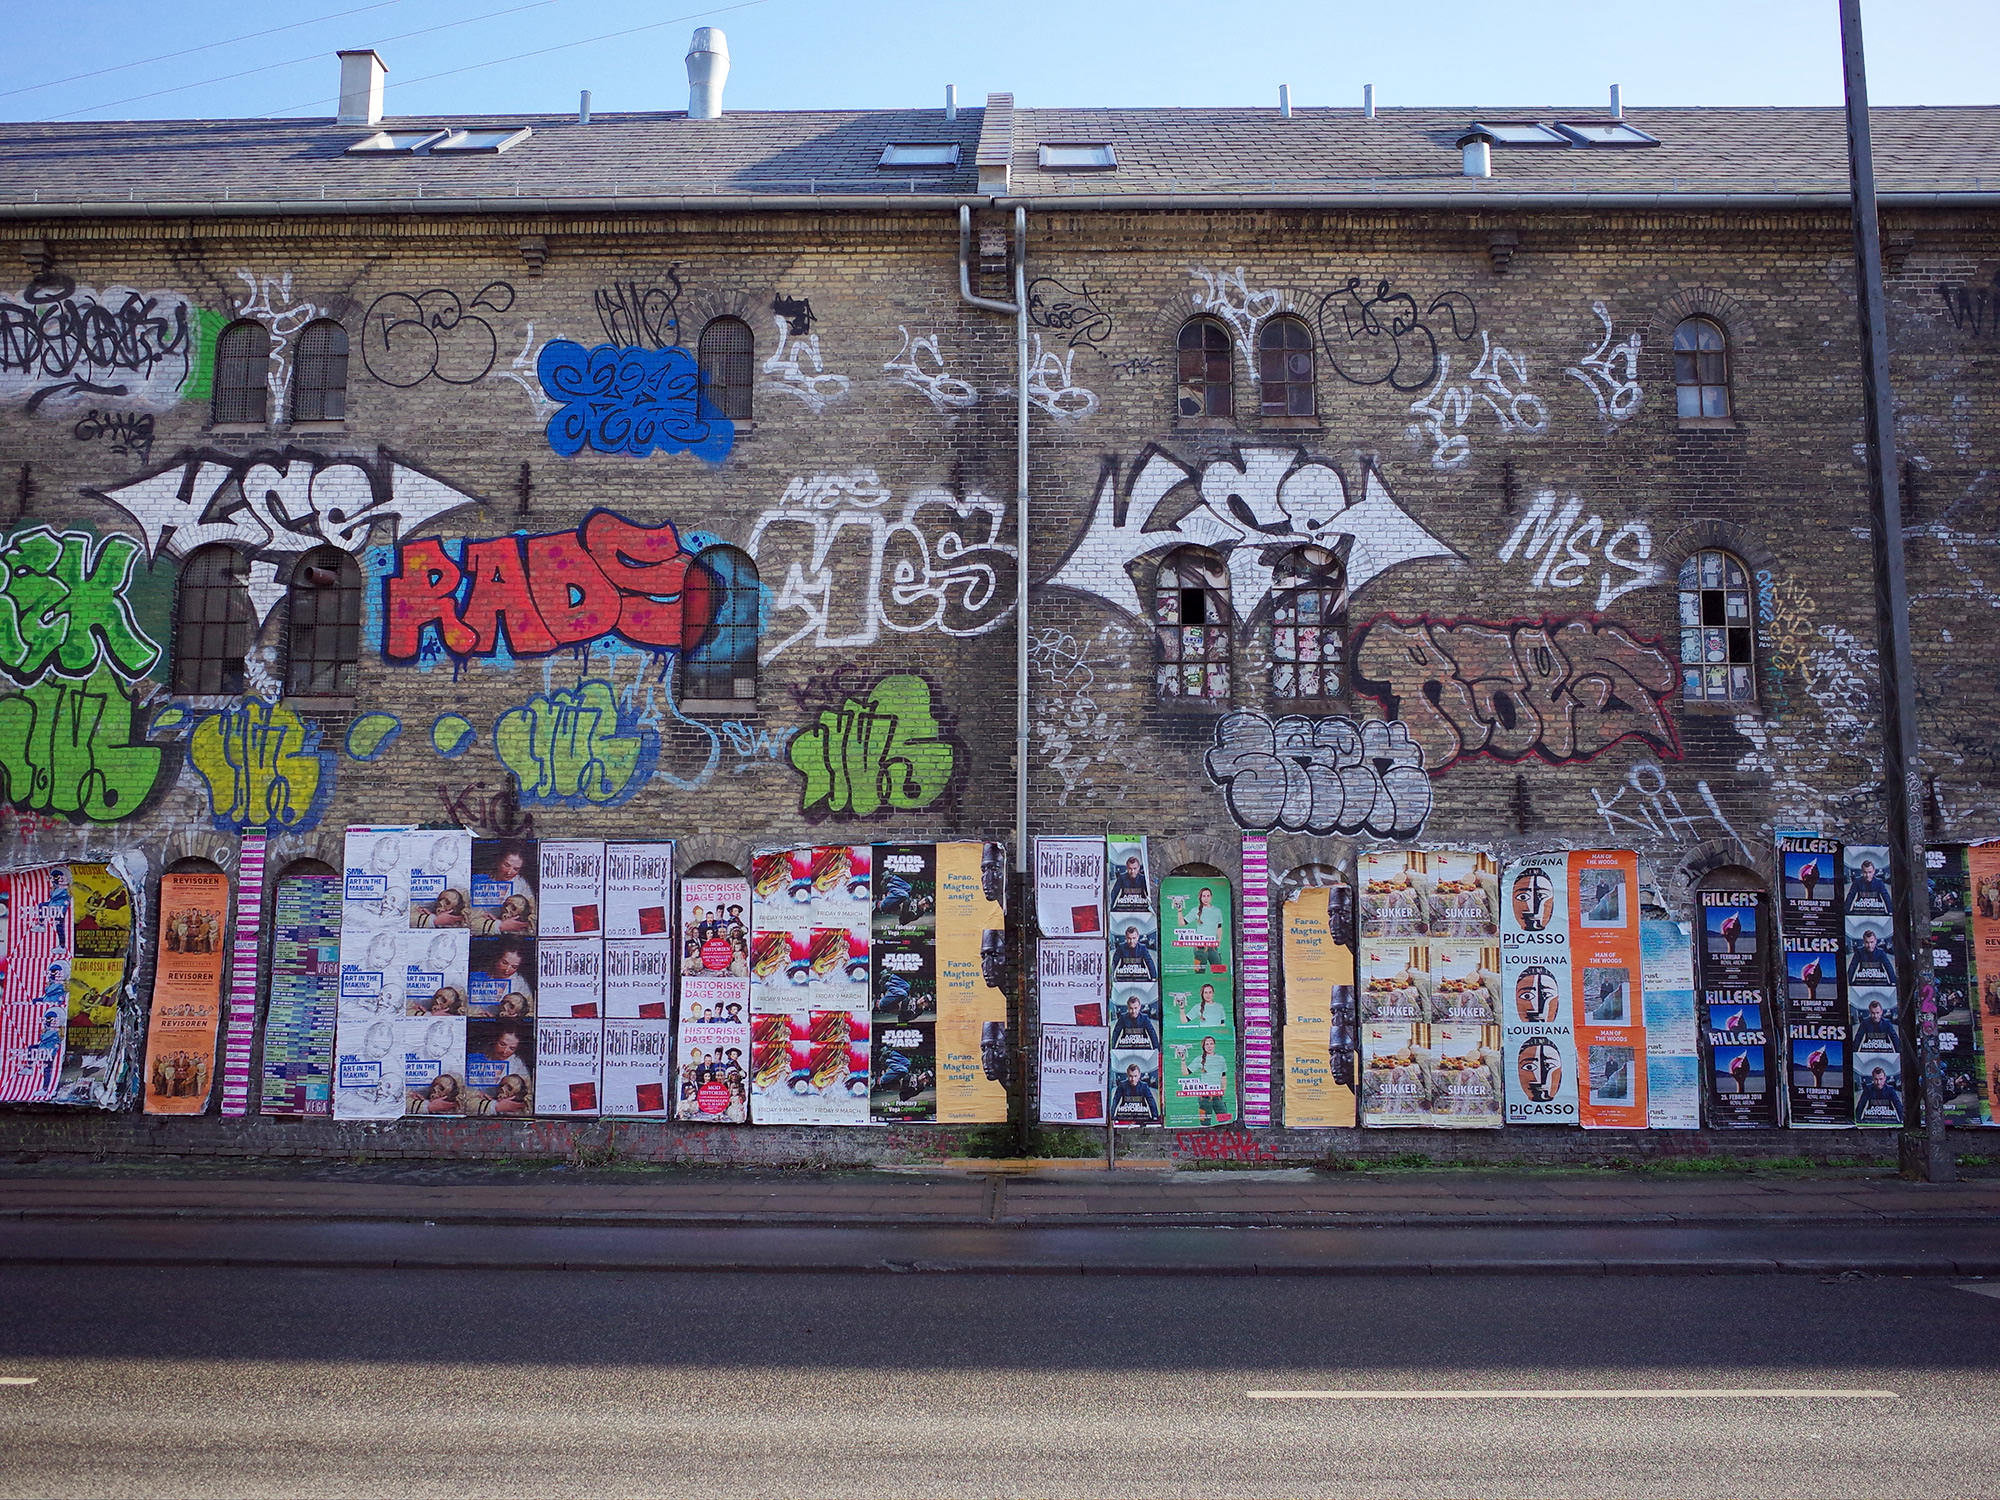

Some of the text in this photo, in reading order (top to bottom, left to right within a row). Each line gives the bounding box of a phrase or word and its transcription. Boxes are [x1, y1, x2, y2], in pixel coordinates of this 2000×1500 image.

[1782, 839, 1838, 853] KILLERS
[884, 855, 925, 864] FLOOR
[1521, 858, 1563, 866] UISIANA
[884, 863, 925, 873] WARS
[173, 877, 219, 885] REVISOREN
[948, 873, 974, 881] Farao.
[566, 883, 601, 893] Ready
[633, 885, 668, 895] Ready
[686, 883, 747, 892] HISTORISKE
[943, 884, 980, 892] Magtens
[1065, 883, 1101, 893] Ready
[686, 893, 742, 902] DAGE 2018
[948, 894, 974, 902] ansigt
[1702, 892, 1758, 907] KILLERS
[1376, 908, 1413, 918] SUKKER
[1445, 908, 1482, 918] SUKKER
[1290, 928, 1328, 937] Magtens
[1296, 937, 1322, 946] ansigt
[1503, 933, 1565, 944] PICASSO
[1783, 938, 1839, 952] KILLERS
[882, 953, 923, 962] FLOOR
[1505, 955, 1567, 964] LOUISIANA
[318, 962, 338, 973] VEGA
[882, 961, 923, 971] WARS
[168, 972, 214, 980] REVISOREN
[943, 970, 980, 979] Magtens
[565, 981, 600, 991] Ready
[633, 981, 668, 991] Ready
[685, 981, 746, 989] HISTORISKE
[949, 980, 975, 989] ansigt
[1068, 981, 1103, 991] Ready
[685, 990, 741, 998] DAGE 2018
[1705, 990, 1762, 1004] KILLERS
[1377, 1006, 1414, 1016] SUKKER
[1448, 1008, 1485, 1017] SUKKER
[161, 1019, 208, 1027] REVISOREN
[684, 1027, 747, 1035] HISTORISKE
[882, 1029, 923, 1039] FLOOR
[1507, 1026, 1570, 1035] LOUISIANA
[1789, 1024, 1846, 1040] KILLERS
[684, 1036, 741, 1044] DAGE 2018
[882, 1038, 923, 1048] WARS
[1709, 1031, 1767, 1045] KILLERS
[563, 1060, 599, 1070] Ready
[631, 1061, 666, 1071] Ready
[943, 1063, 980, 1071] Magtens
[1069, 1067, 1105, 1079] Ready
[1291, 1067, 1328, 1075] Magtens
[949, 1073, 975, 1082] ansigt
[1296, 1077, 1323, 1086] ansigt
[1380, 1083, 1417, 1094] SUKKER
[1448, 1085, 1486, 1095] SUKKER
[305, 1101, 327, 1112] VEGA
[1510, 1104, 1574, 1115] PICASSO
